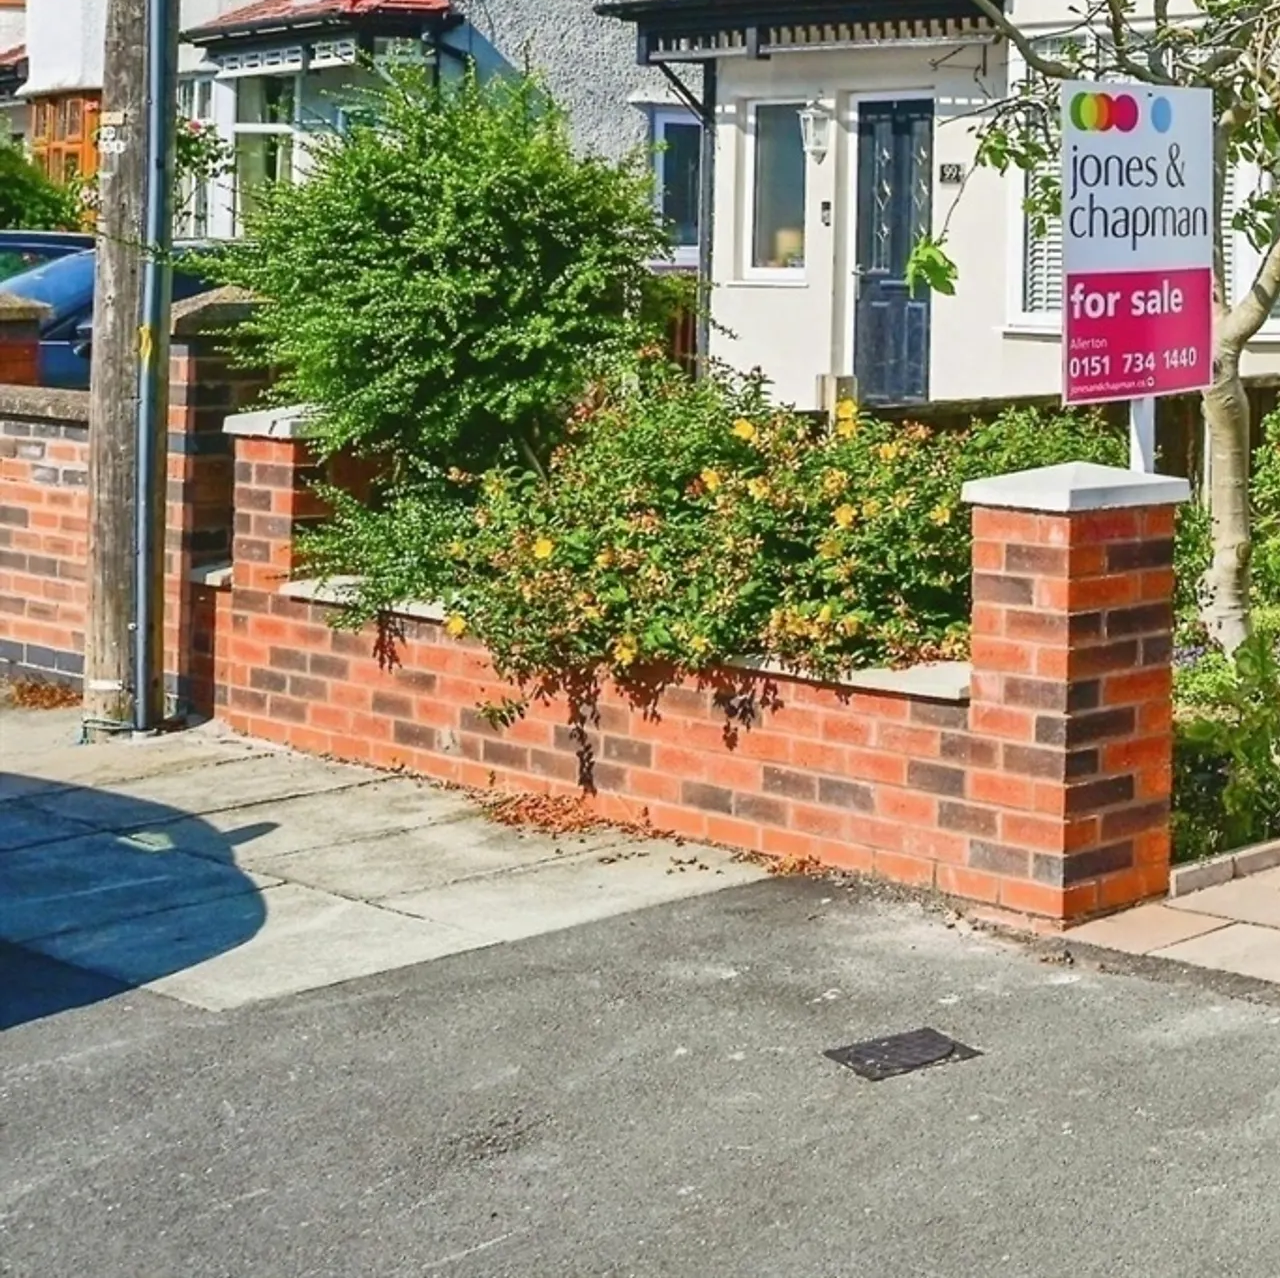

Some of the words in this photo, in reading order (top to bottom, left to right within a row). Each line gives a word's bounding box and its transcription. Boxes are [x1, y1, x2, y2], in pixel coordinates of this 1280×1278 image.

[1070, 145, 1158, 200] jones
[1166, 142, 1186, 188] &
[1070, 193, 1207, 251] chapman
[1070, 282, 1121, 319] for
[1131, 279, 1183, 316] sale
[1069, 355, 1110, 378] 0151
[1122, 352, 1156, 374] 734
[1163, 346, 1197, 369] 1440
[1070, 337, 1108, 350] Allerton
